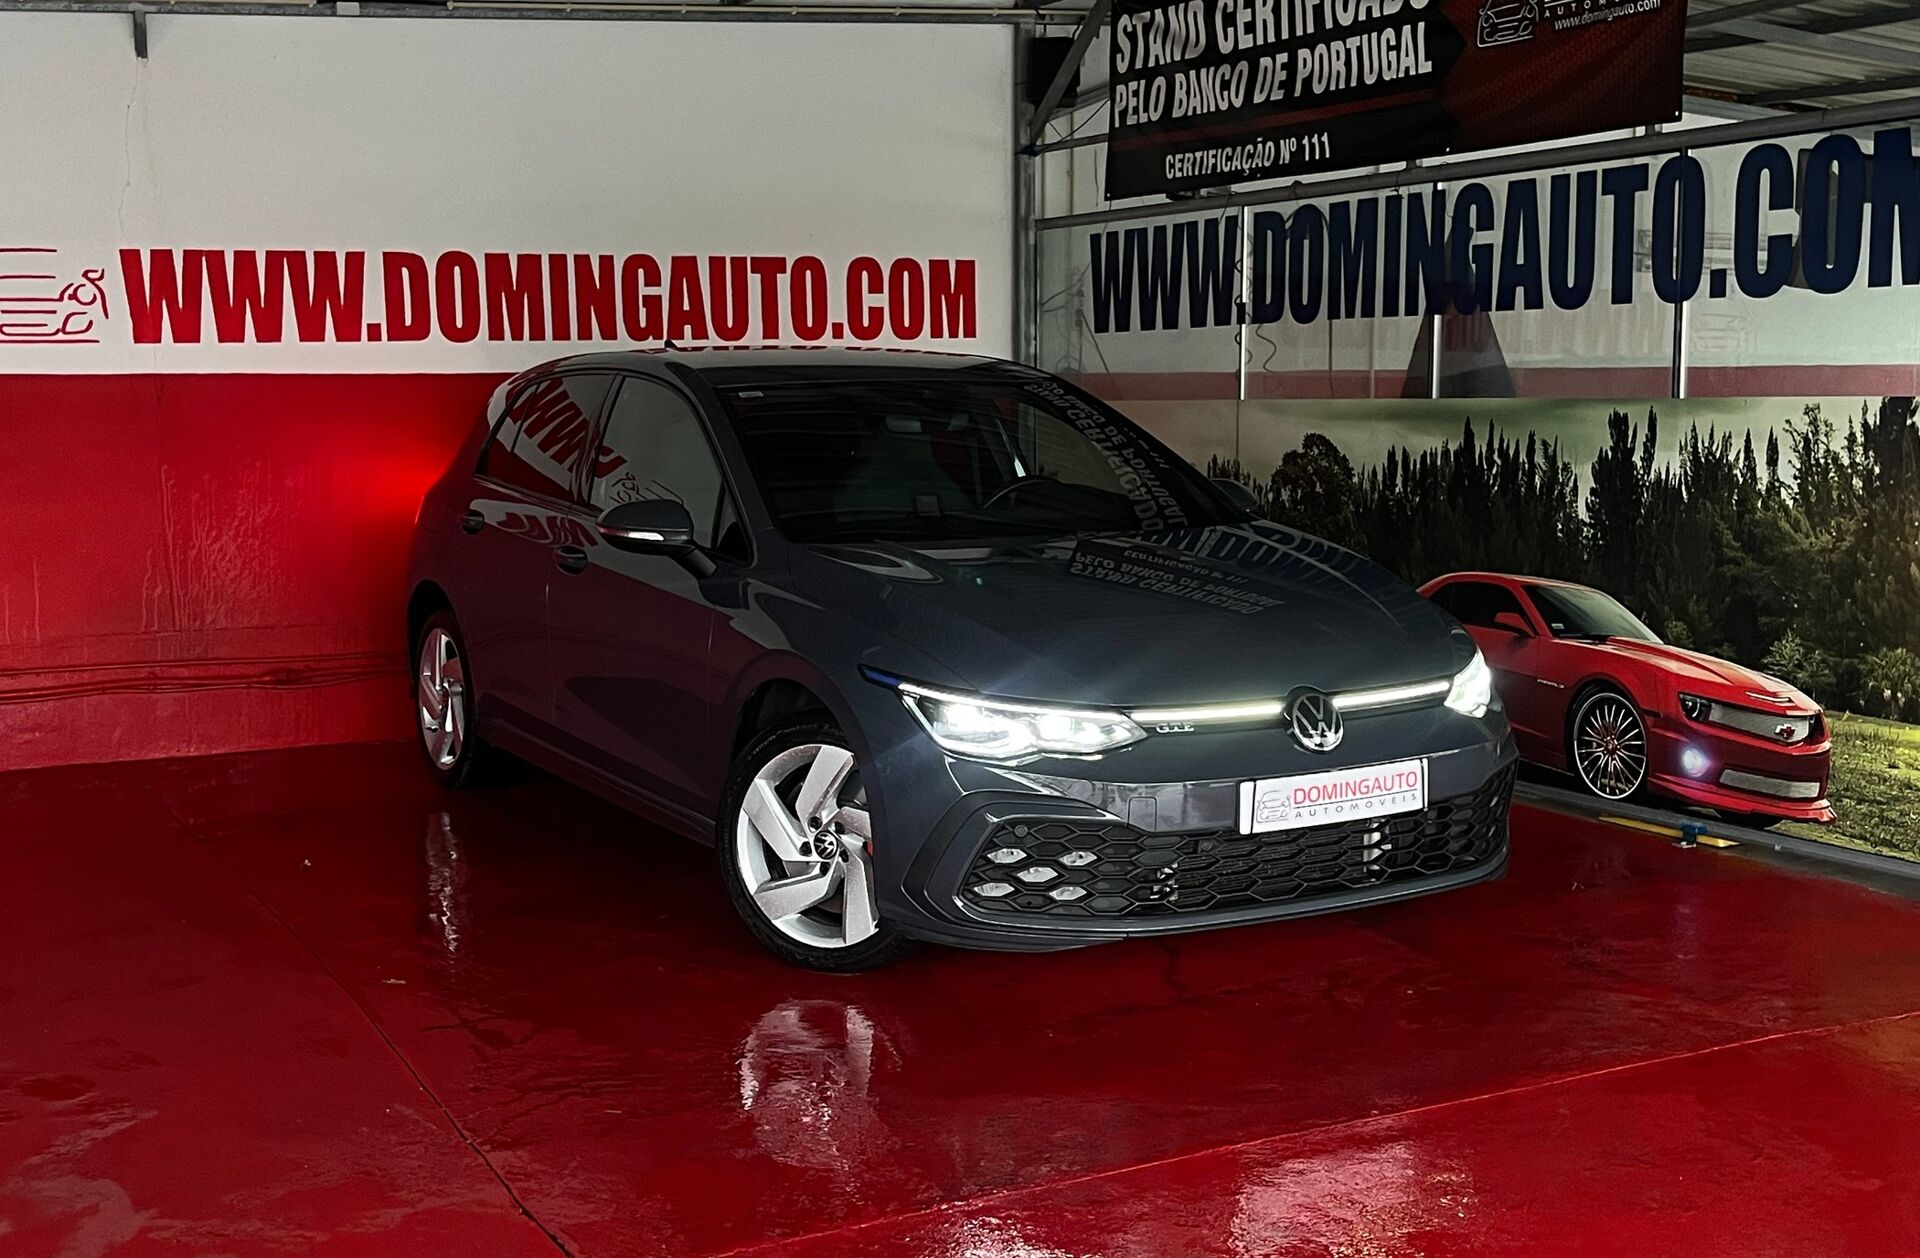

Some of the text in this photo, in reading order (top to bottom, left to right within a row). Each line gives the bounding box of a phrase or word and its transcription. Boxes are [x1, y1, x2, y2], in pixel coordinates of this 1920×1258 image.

[1115, 0, 1207, 74] STAND
[1113, 21, 1433, 128] PELO BANCO DE PORTUGAL
[1165, 137, 1275, 180] CERTIFICAÇÃO
[1302, 131, 1331, 162] 111
[119, 248, 976, 344] WWW.DOMINGAUTO.COM
[1294, 771, 1418, 806] DOMINGAUTO
[1295, 793, 1417, 819] AUTOMOVEIS
